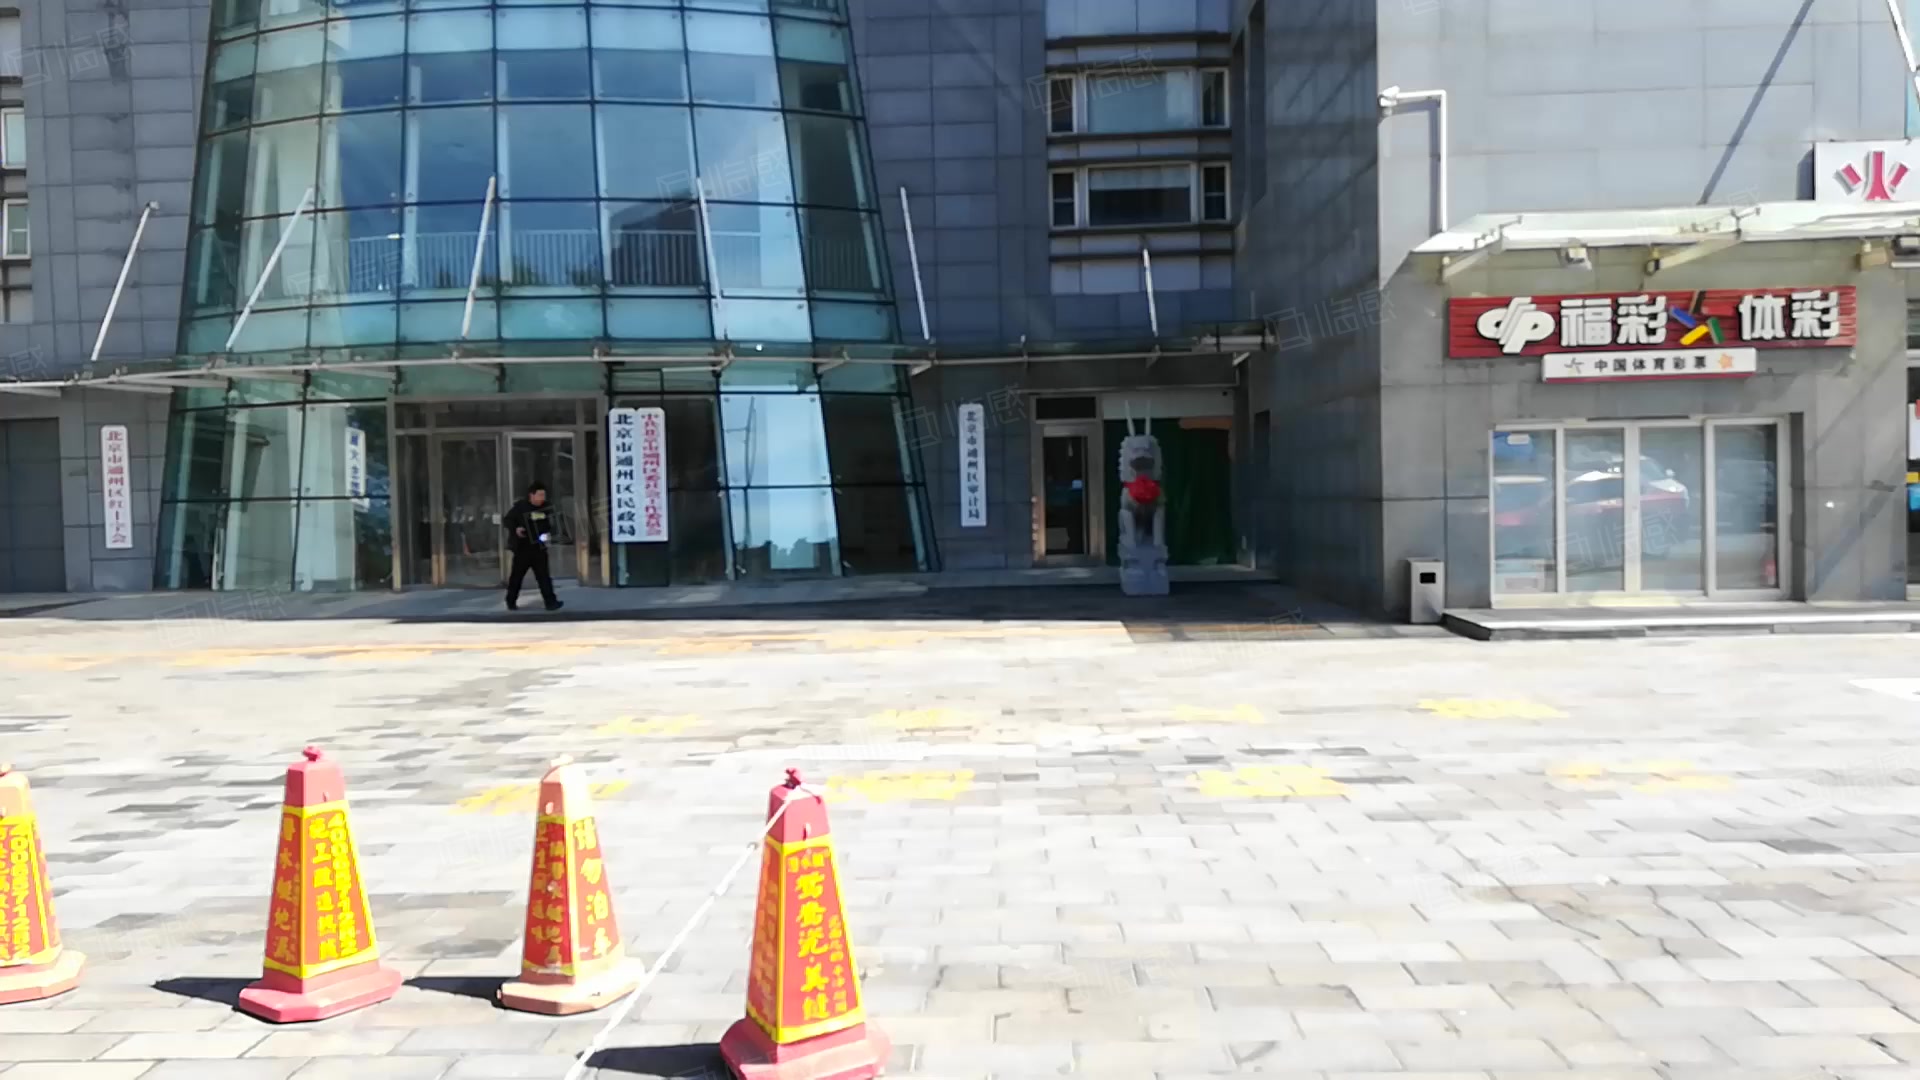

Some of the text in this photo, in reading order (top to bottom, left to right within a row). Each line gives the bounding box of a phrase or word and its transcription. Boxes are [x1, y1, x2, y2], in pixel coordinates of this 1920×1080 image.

[1559, 289, 1839, 347] 福彩 体彩
[1593, 355, 1708, 372] 中国体育彩票
[106, 430, 127, 544] 北京市通州区红十字会
[614, 414, 636, 537] 北京市通州区民政局
[573, 816, 612, 956] 请勿泊车
